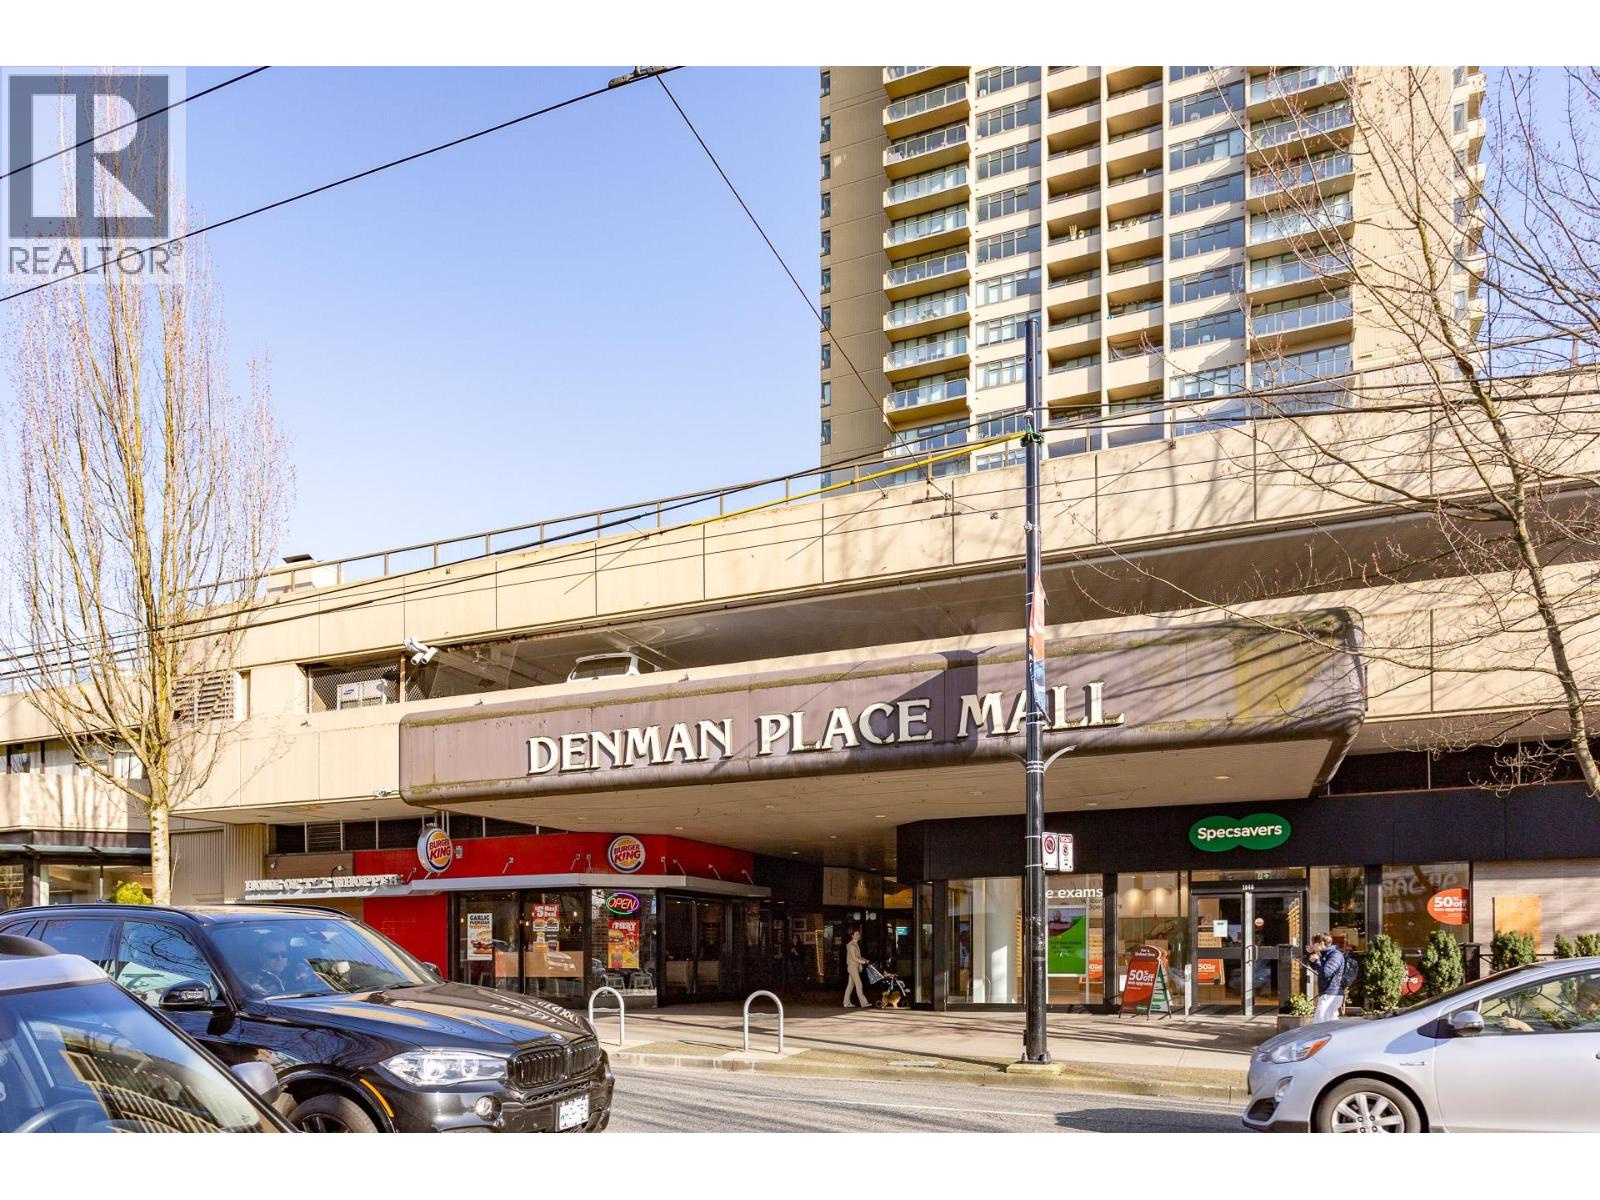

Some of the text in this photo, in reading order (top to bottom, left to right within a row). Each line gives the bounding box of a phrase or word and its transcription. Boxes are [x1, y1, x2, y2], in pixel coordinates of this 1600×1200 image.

[526, 717, 735, 777] DENMAN
[755, 698, 933, 757] PLACE
[1197, 824, 1283, 842] Specsavers
[429, 838, 450, 849] BURGER
[613, 844, 641, 855] BURGER
[429, 846, 451, 861] KING
[614, 850, 641, 864] KING
[1058, 887, 1104, 899] exams
[607, 897, 637, 911] OPEN
